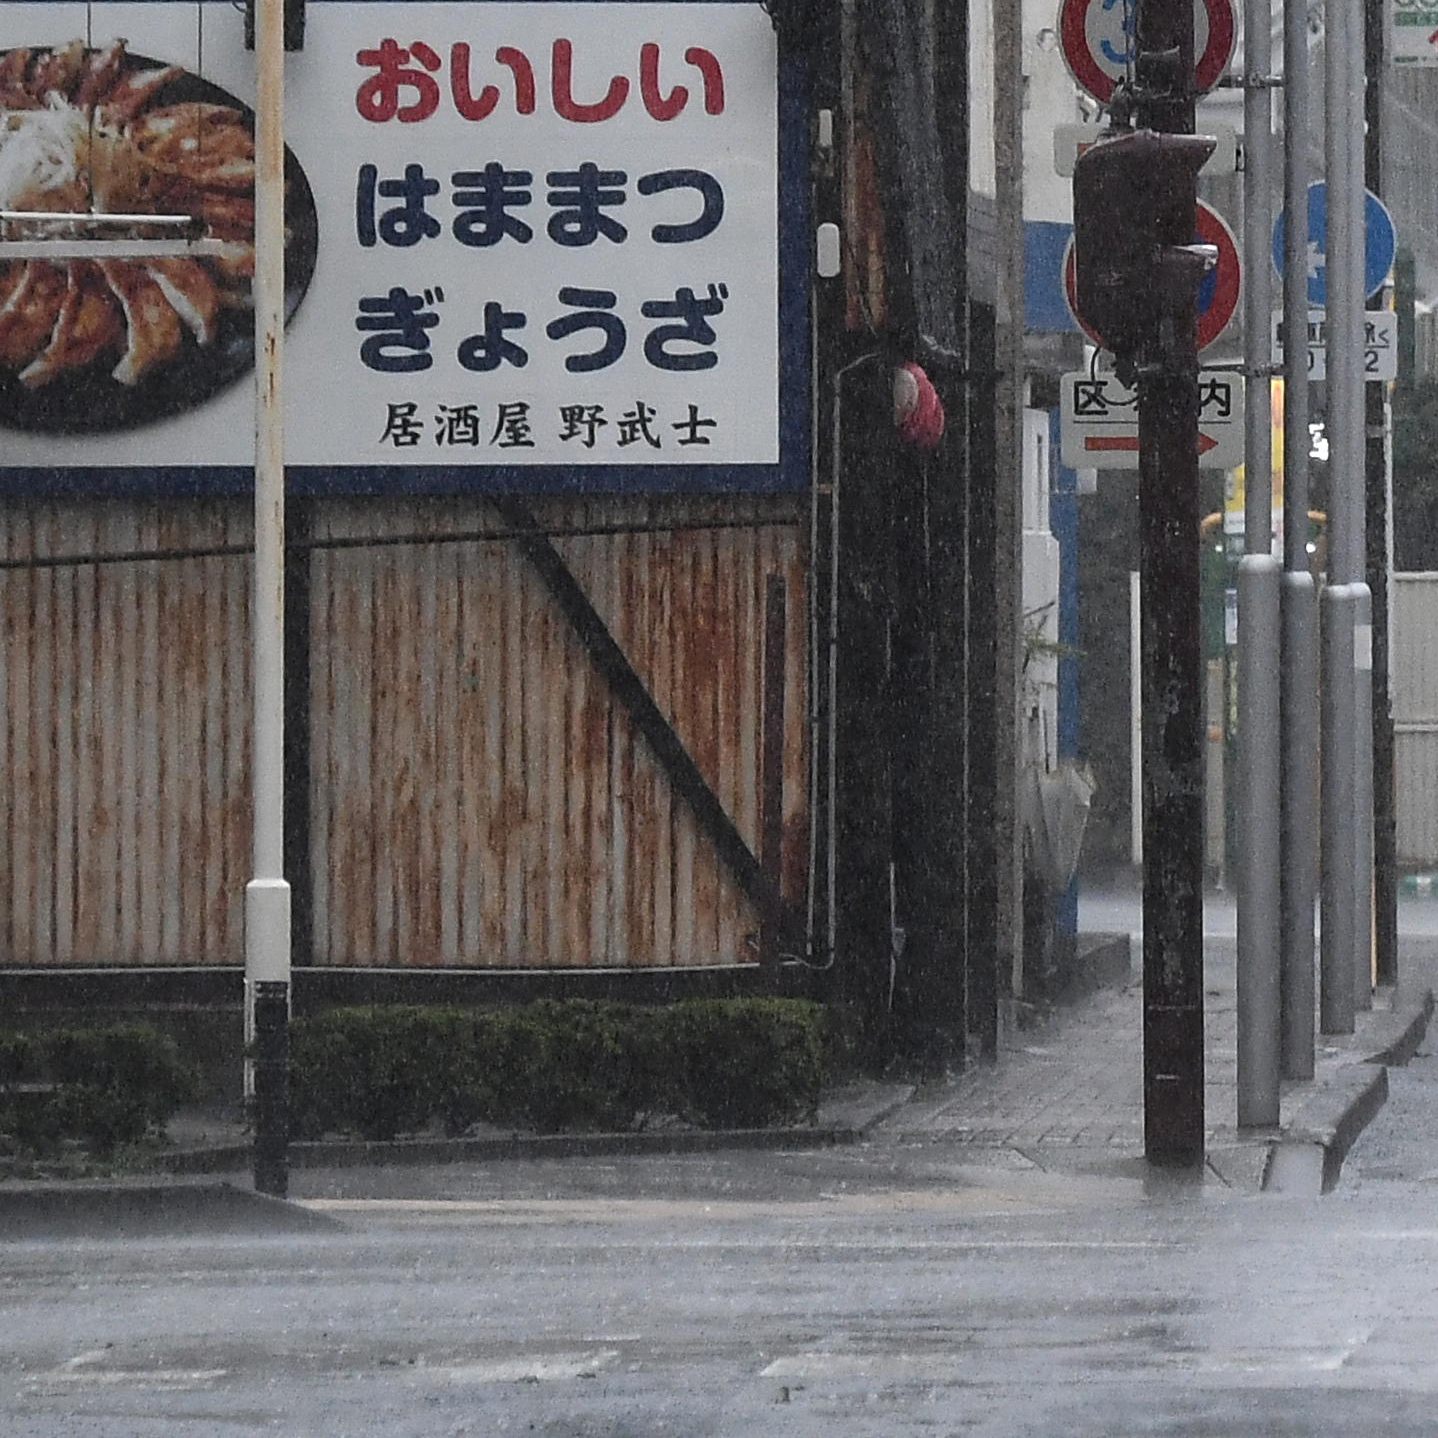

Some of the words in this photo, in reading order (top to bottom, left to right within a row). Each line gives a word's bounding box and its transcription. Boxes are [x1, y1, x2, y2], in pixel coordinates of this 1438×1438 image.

[355, 38, 725, 123] おいしい
[356, 161, 725, 248] はままつ
[355, 283, 728, 373] ぎょうざ
[380, 402, 536, 449] 居酒屋
[560, 401, 718, 449] 野武士
[1074, 378, 1231, 416] 区内
